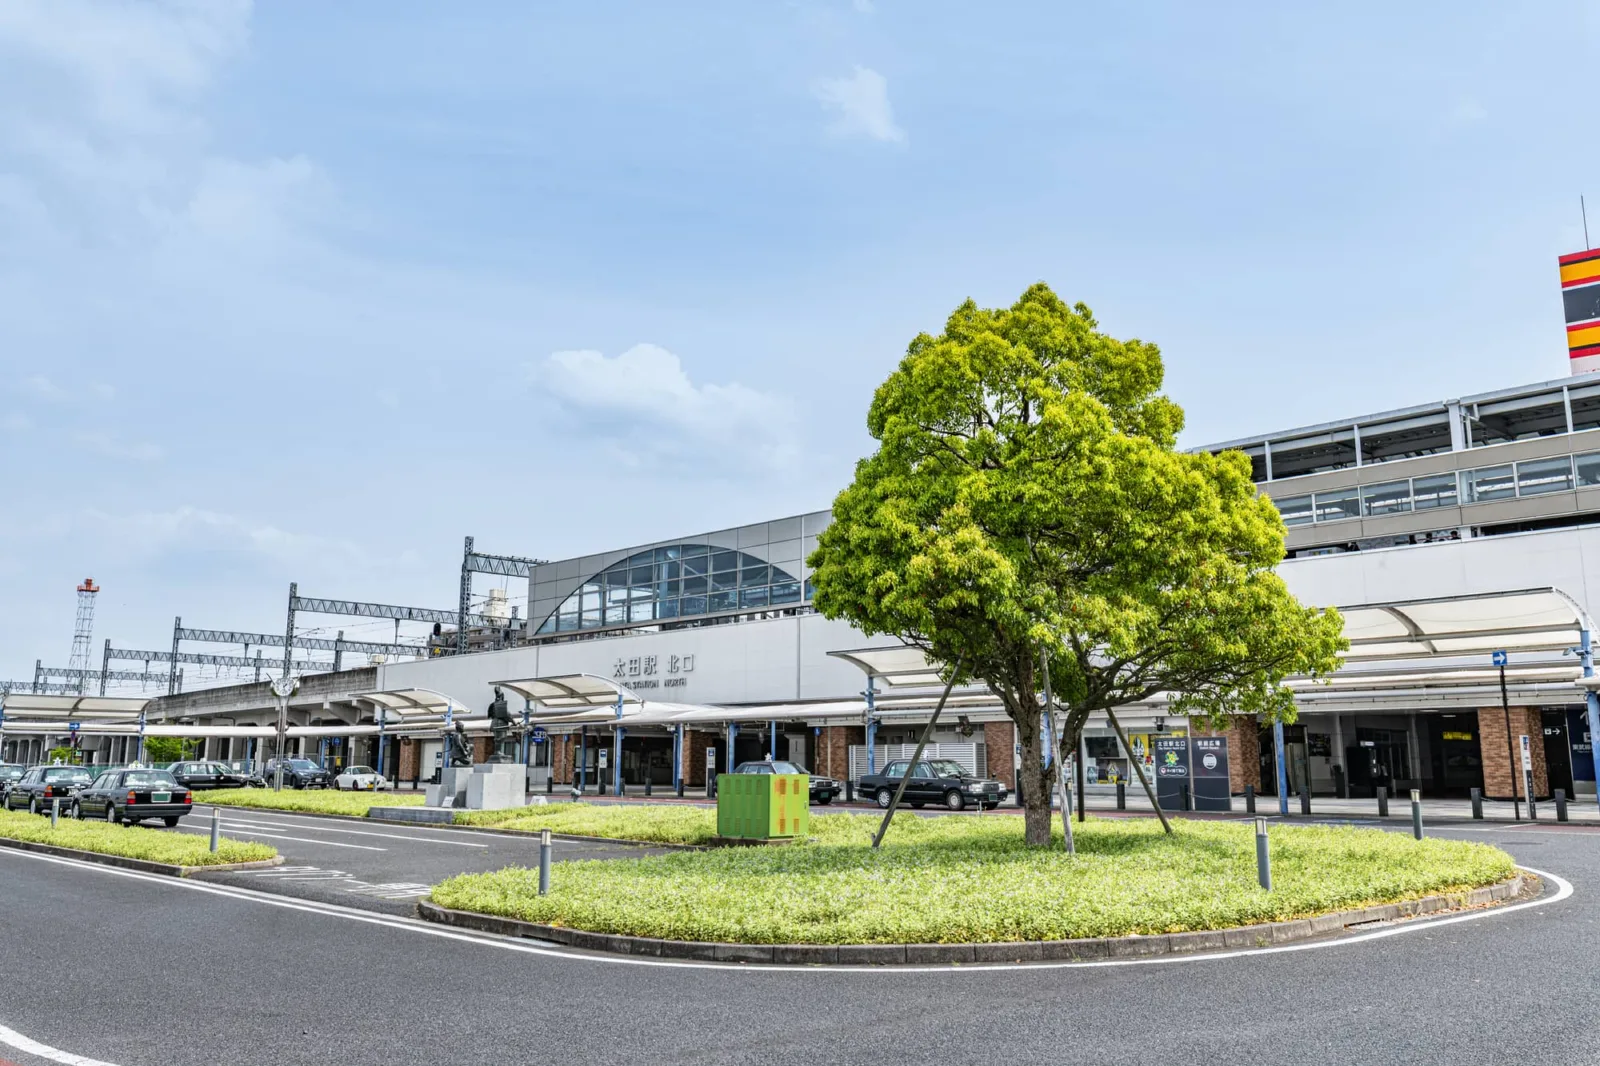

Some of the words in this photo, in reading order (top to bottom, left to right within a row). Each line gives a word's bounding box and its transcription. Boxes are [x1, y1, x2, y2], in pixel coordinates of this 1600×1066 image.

[613, 655, 658, 678] 太田駅
[667, 654, 694, 674] 北口
[632, 679, 660, 689] STATION
[664, 678, 687, 687] NORTH
